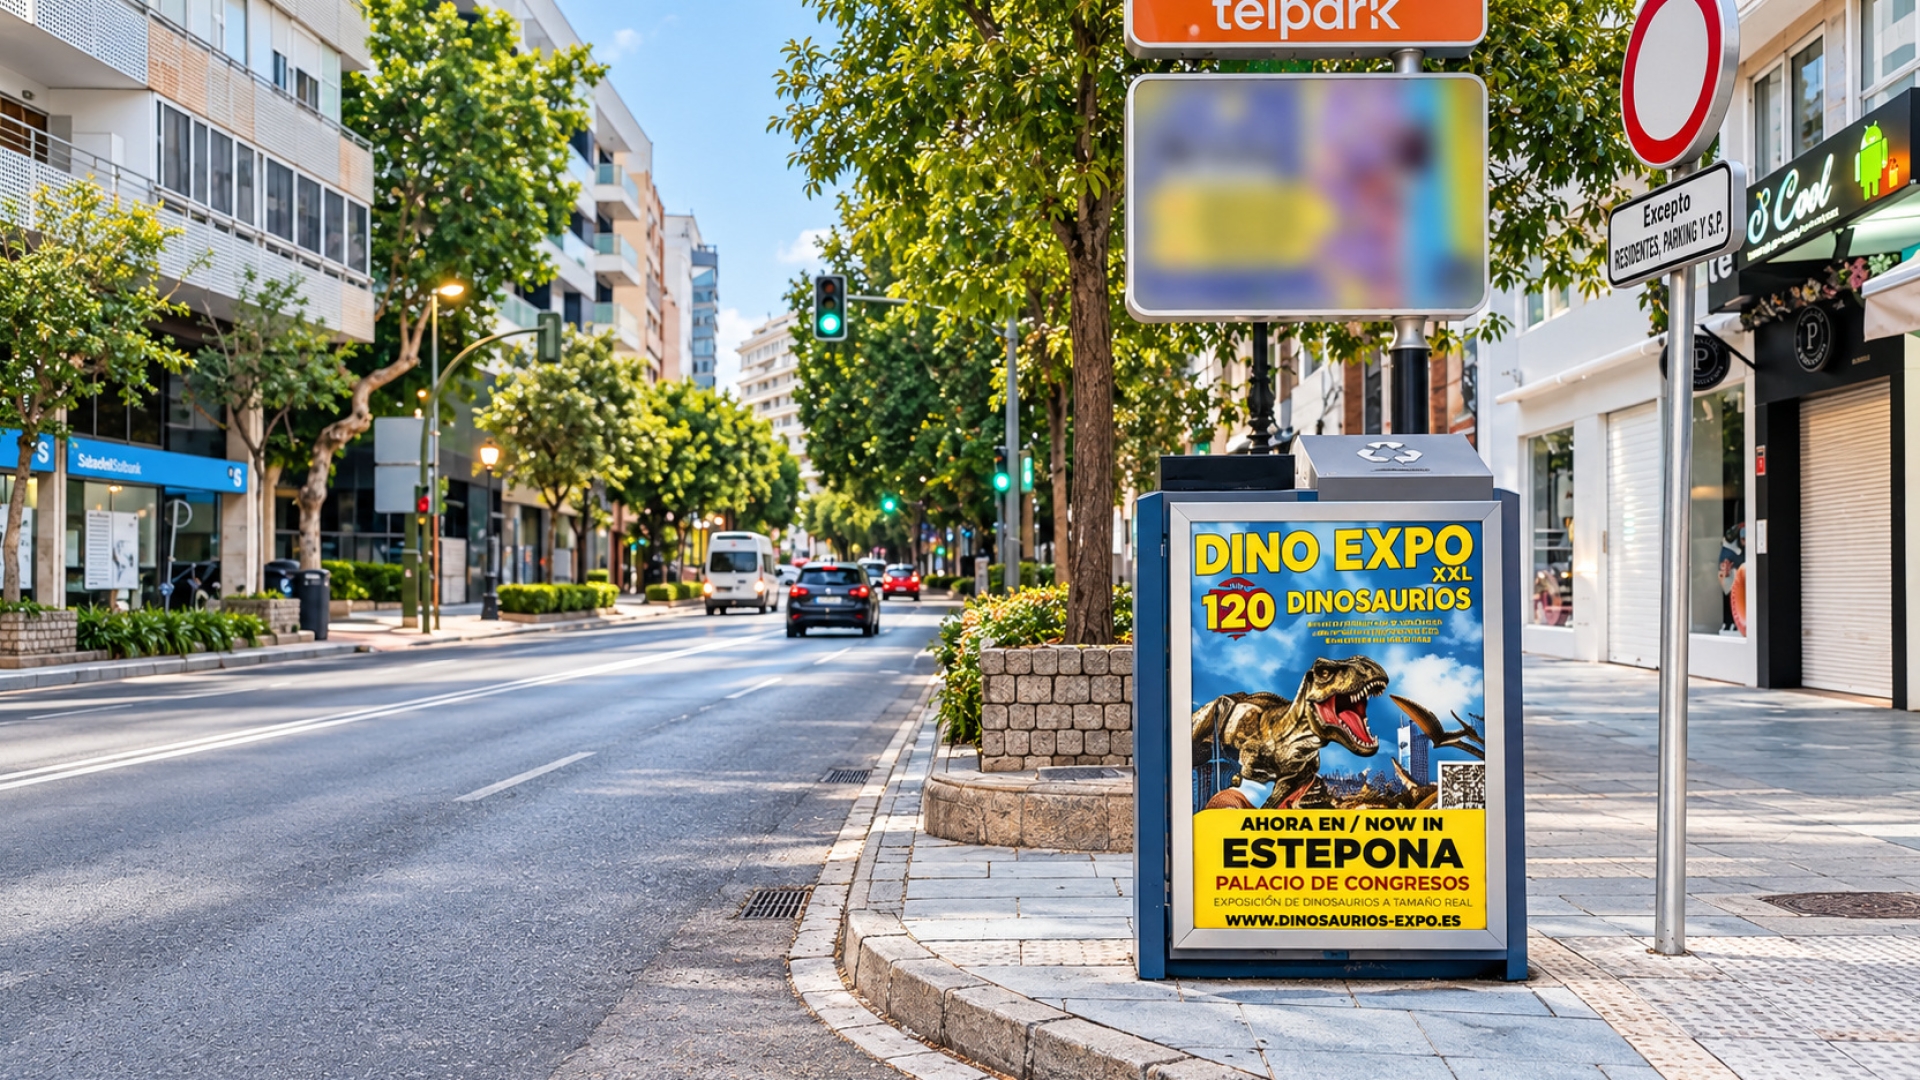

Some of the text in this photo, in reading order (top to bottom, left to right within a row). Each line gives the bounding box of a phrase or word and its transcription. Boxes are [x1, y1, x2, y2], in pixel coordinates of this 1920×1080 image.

[1212, 0, 1400, 40] telpark
[1774, 153, 1834, 231] Cool
[1643, 193, 1691, 228] Excepto
[1614, 235, 1661, 271] RESIDENTES,
[1663, 220, 1697, 253] PARKING
[1700, 216, 1706, 239] Y
[1708, 210, 1724, 237] S.P.
[1195, 524, 1473, 576] DINO EXPO
[1432, 566, 1473, 583] XXL
[1202, 586, 1472, 631] 120 DINOSAURIOS
[1240, 814, 1443, 833] AHORA EN / NOW IN
[1223, 837, 1464, 869] ESTEPONA
[1215, 875, 1470, 891] PALACIO DE CONGRESOS
[1214, 895, 1473, 907] EXPOSICIÓN DE DINOSAURIOS A TAMAÑO REAL
[1226, 914, 1461, 927] WWW.DINOSAURIOS-EXPO.ES
